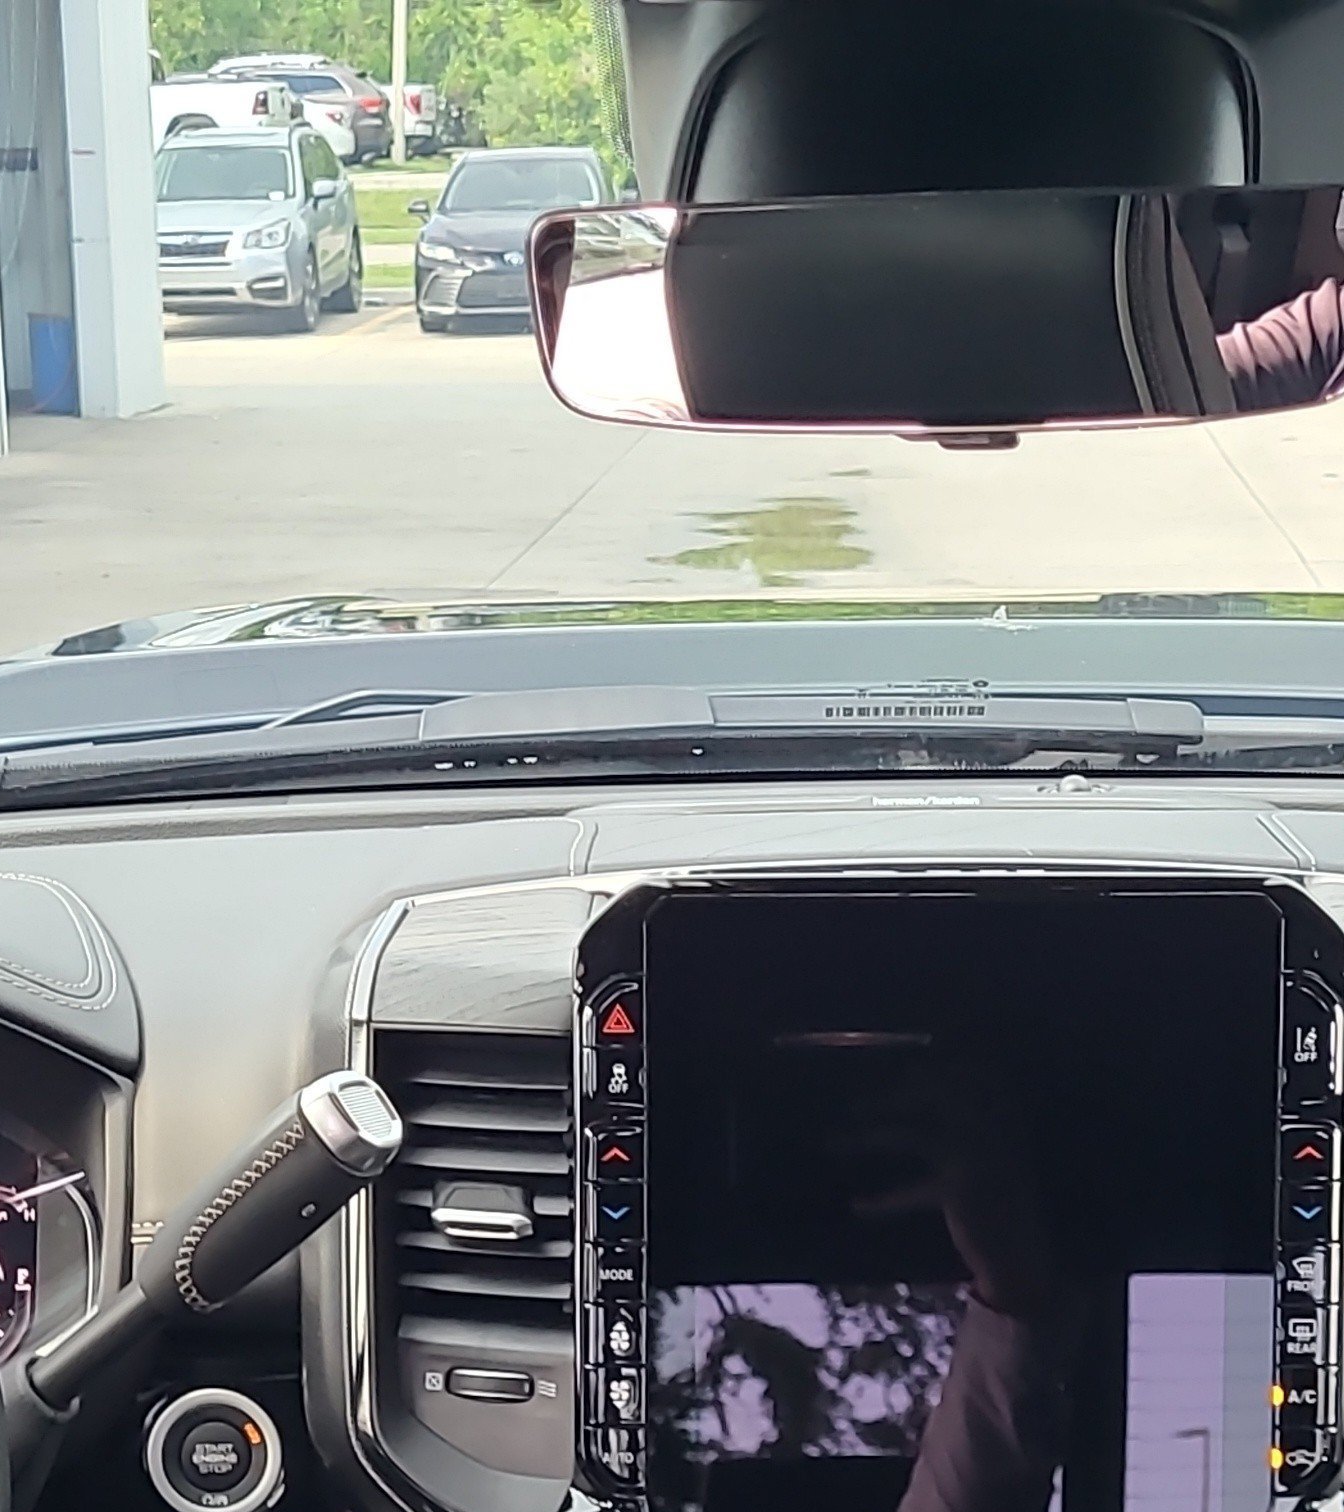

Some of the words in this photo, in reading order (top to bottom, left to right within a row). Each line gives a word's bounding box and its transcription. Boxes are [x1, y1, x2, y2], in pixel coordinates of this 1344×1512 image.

[1294, 1052, 1318, 1063] OFF
[608, 1083, 629, 1094] OFF
[599, 1269, 634, 1281] MODE
[1288, 1390, 1317, 1404] A/C
